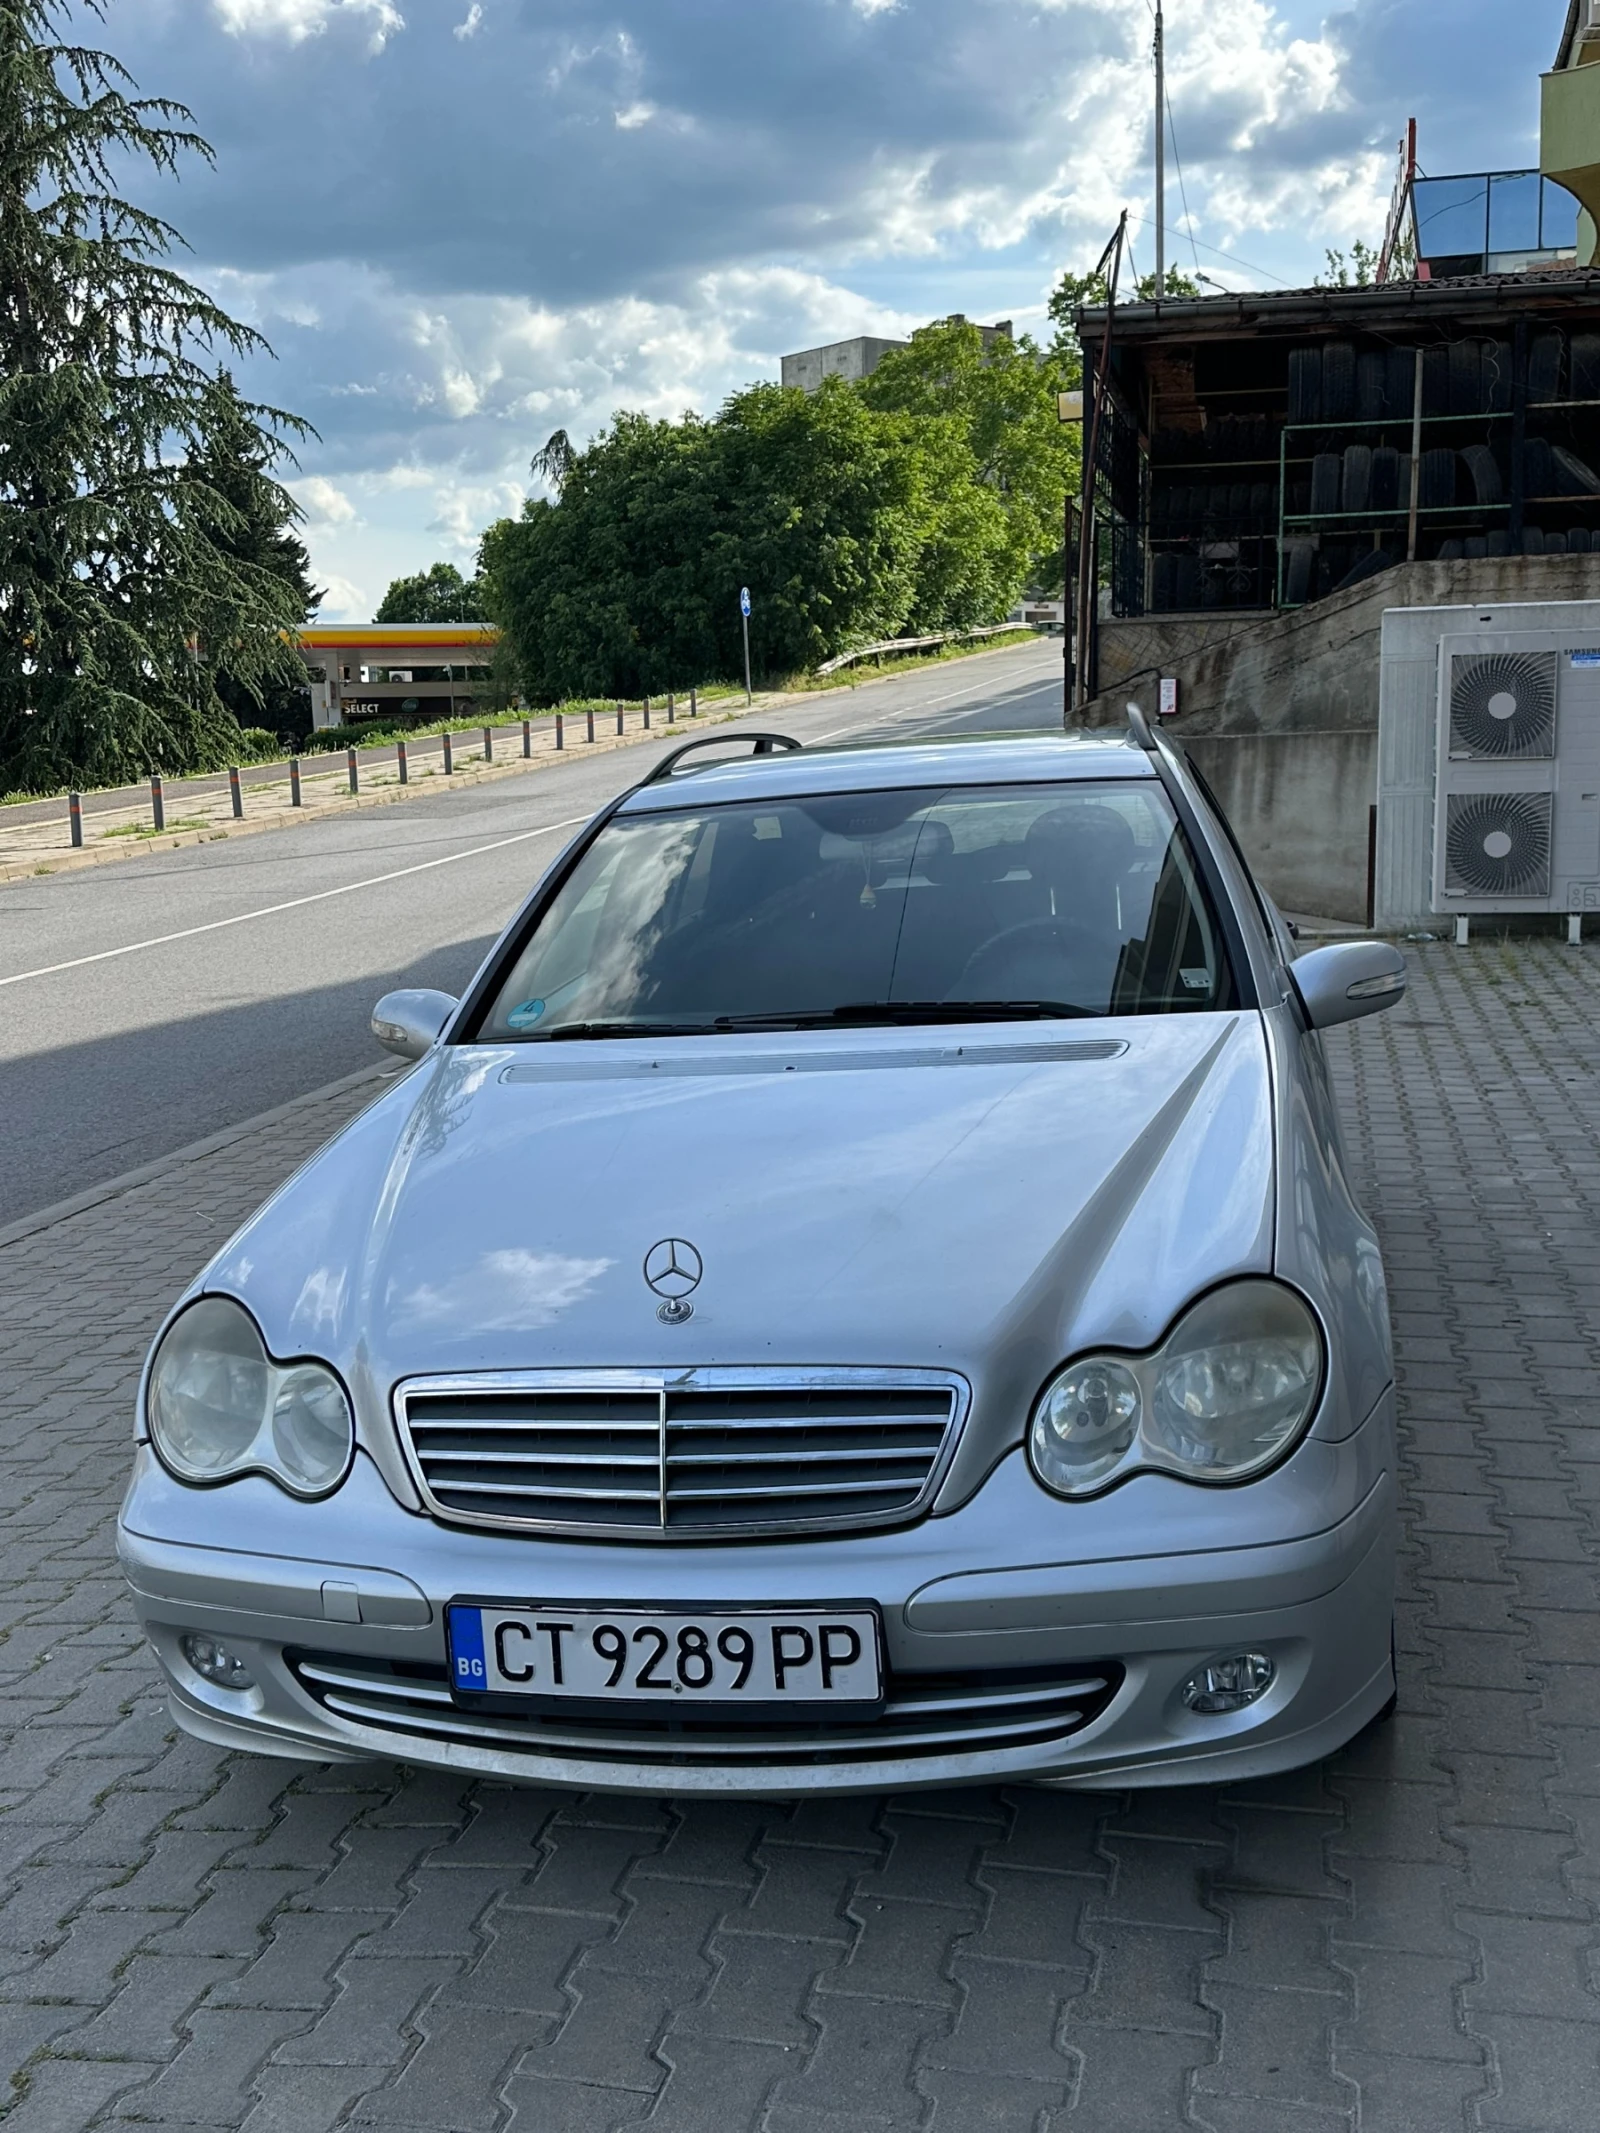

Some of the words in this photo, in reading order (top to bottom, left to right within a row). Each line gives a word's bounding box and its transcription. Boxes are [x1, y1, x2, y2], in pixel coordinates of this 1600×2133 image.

[345, 703, 379, 713] SELECT
[523, 1000, 536, 1012] 4
[495, 1621, 573, 1684] CT
[592, 1625, 754, 1688] 9289
[771, 1625, 861, 1689] PP
[457, 1657, 483, 1676] BG
